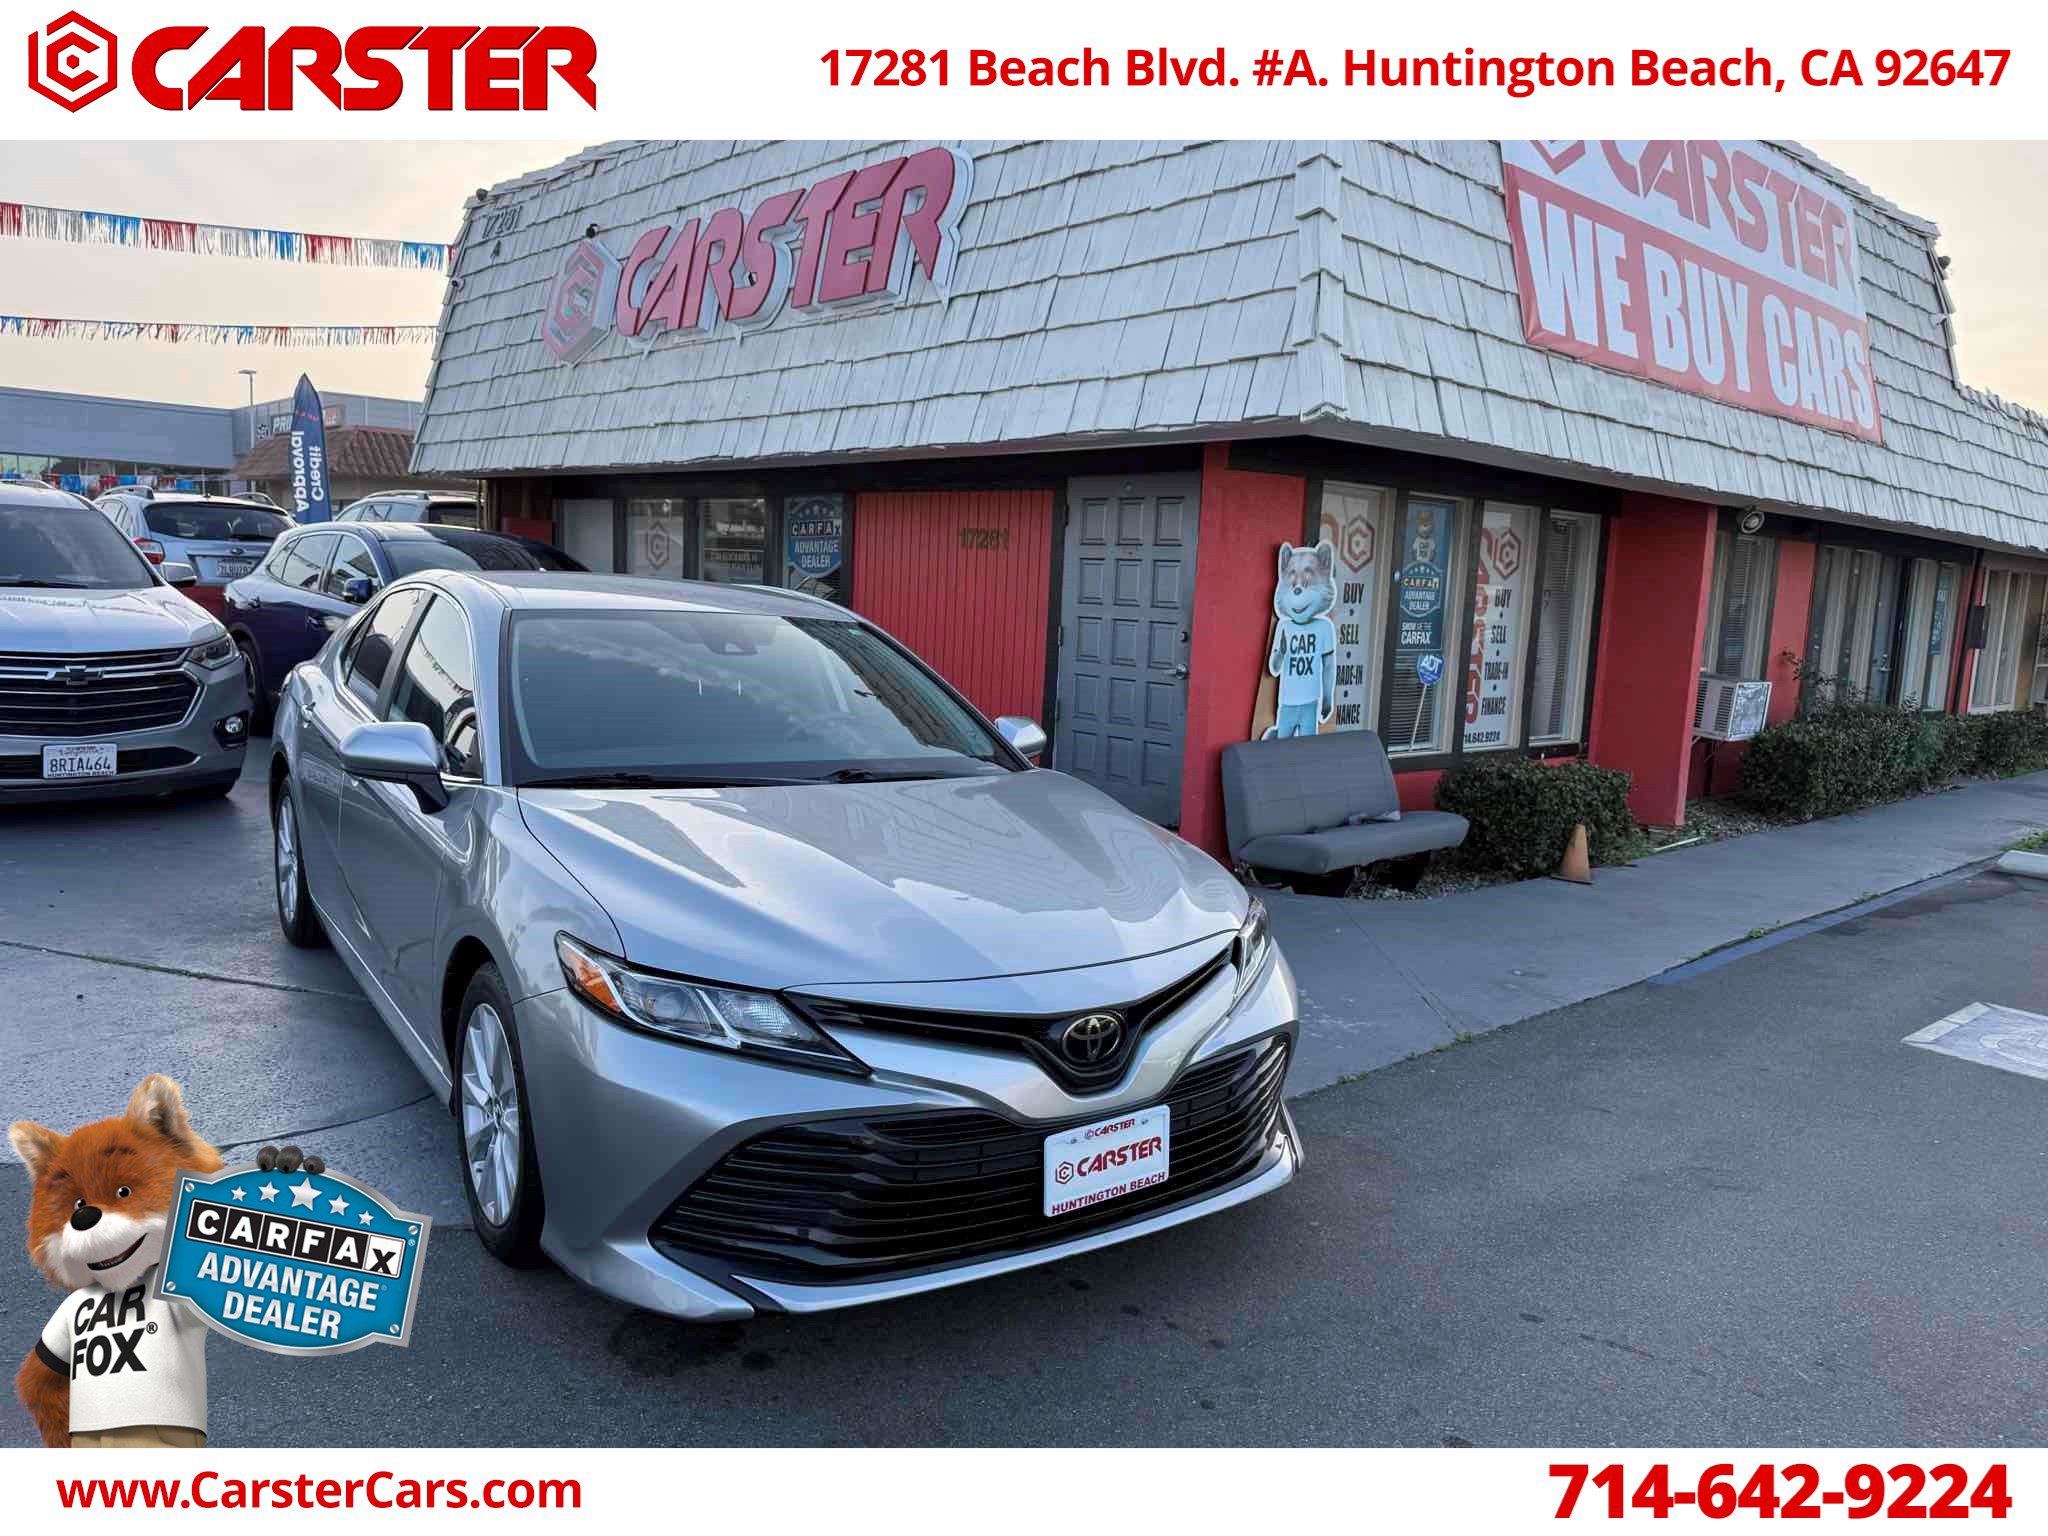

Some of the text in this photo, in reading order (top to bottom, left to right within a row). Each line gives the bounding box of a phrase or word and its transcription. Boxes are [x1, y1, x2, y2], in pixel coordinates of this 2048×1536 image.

[616, 147, 960, 337] CARSTER
[1519, 190, 1875, 430] WE BUY CARS
[792, 519, 842, 537] CARFAX
[794, 540, 839, 553] ADVANTAGE
[801, 554, 831, 569] DEALER
[1343, 582, 1365, 605] BUY
[1494, 588, 1512, 608] BUY
[1289, 633, 1317, 655] CAR
[1339, 623, 1360, 645] SELL
[1401, 631, 1432, 645] CARFAX
[1490, 625, 1507, 645] SELL
[1289, 656, 1315, 677] FOX
[1421, 654, 1443, 673] ADT
[1483, 661, 1509, 681] TRADE-IN
[1336, 664, 1364, 686] RADE-IN
[1335, 704, 1361, 726] NANCE
[1480, 696, 1507, 717] FINANCE
[1464, 730, 1500, 744] 14.642.9224
[1094, 1118, 1136, 1138] CARSTER
[1076, 1135, 1162, 1178] CARSTER
[1052, 1171, 1166, 1215] HUNTINGTON BEACH
